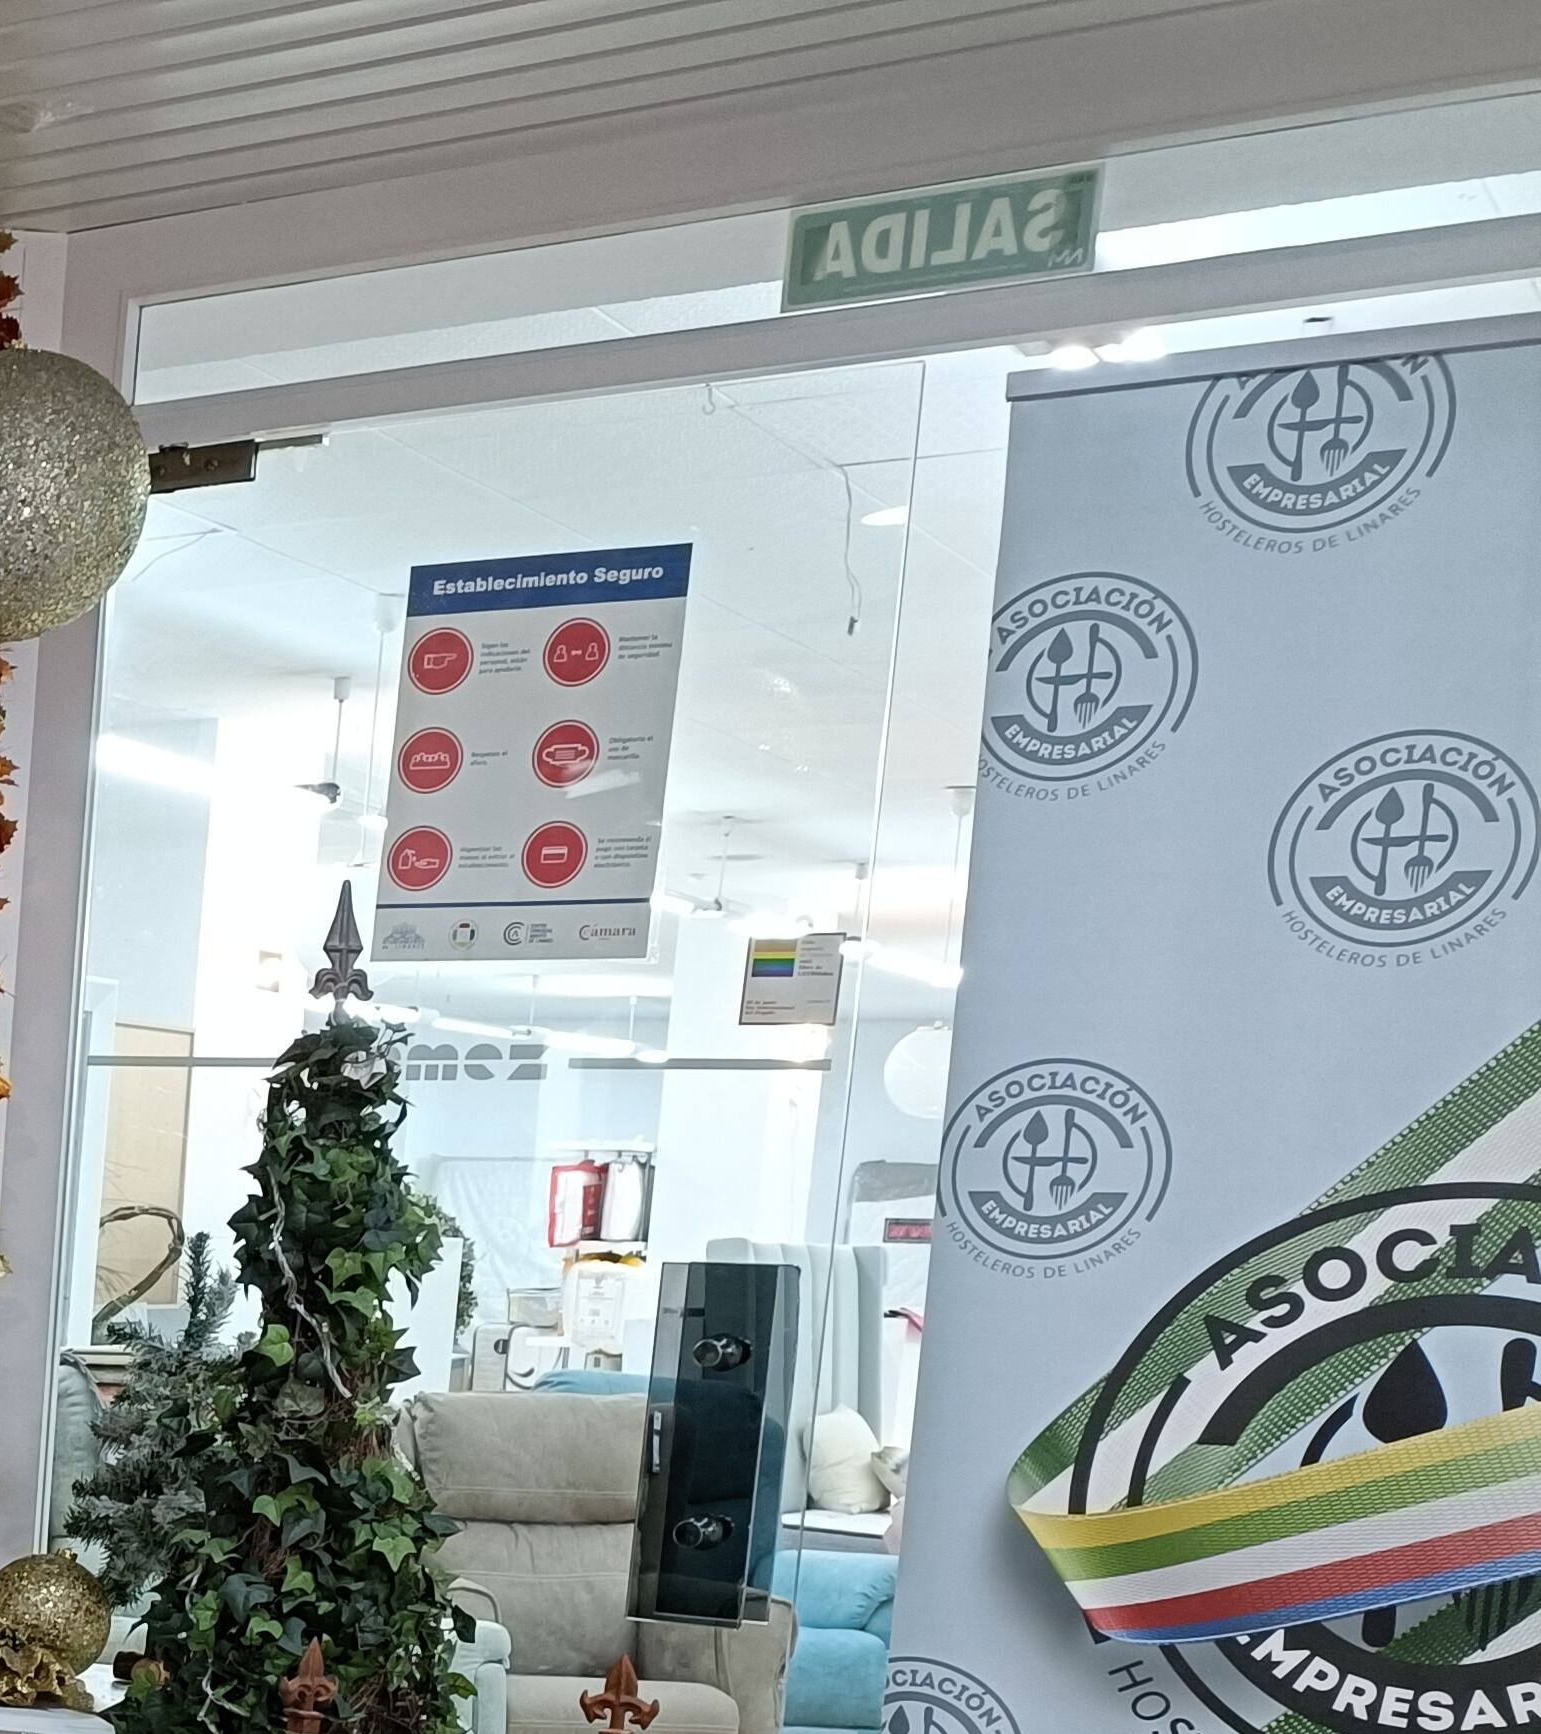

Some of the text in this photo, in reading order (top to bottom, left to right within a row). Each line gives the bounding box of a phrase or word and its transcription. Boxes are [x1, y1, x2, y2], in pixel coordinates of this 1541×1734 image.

[1242, 462, 1390, 510] EMPRESARIAL
[1199, 486, 1422, 553] HOSTELEROS DE LINARES
[432, 564, 664, 596] Establecimiento Seguro
[996, 585, 1174, 646] ASOCIACIÓN
[1004, 717, 1138, 760] EMPRESARIAL
[977, 740, 1167, 802] OSTELEROS DE LINARES
[1317, 743, 1517, 804] ASOCIACIÓN
[1325, 881, 1476, 925] EMPRESARIAL
[1281, 906, 1508, 968] HOSTELEROS DE LINARES
[974, 1070, 1148, 1126] ASOCIACIÓN
[981, 1200, 1115, 1239] EMPRESARIAL
[945, 1221, 1142, 1279] HOSTELEROS DE LINARES
[1236, 1629, 1541, 1732] MPRESAR
